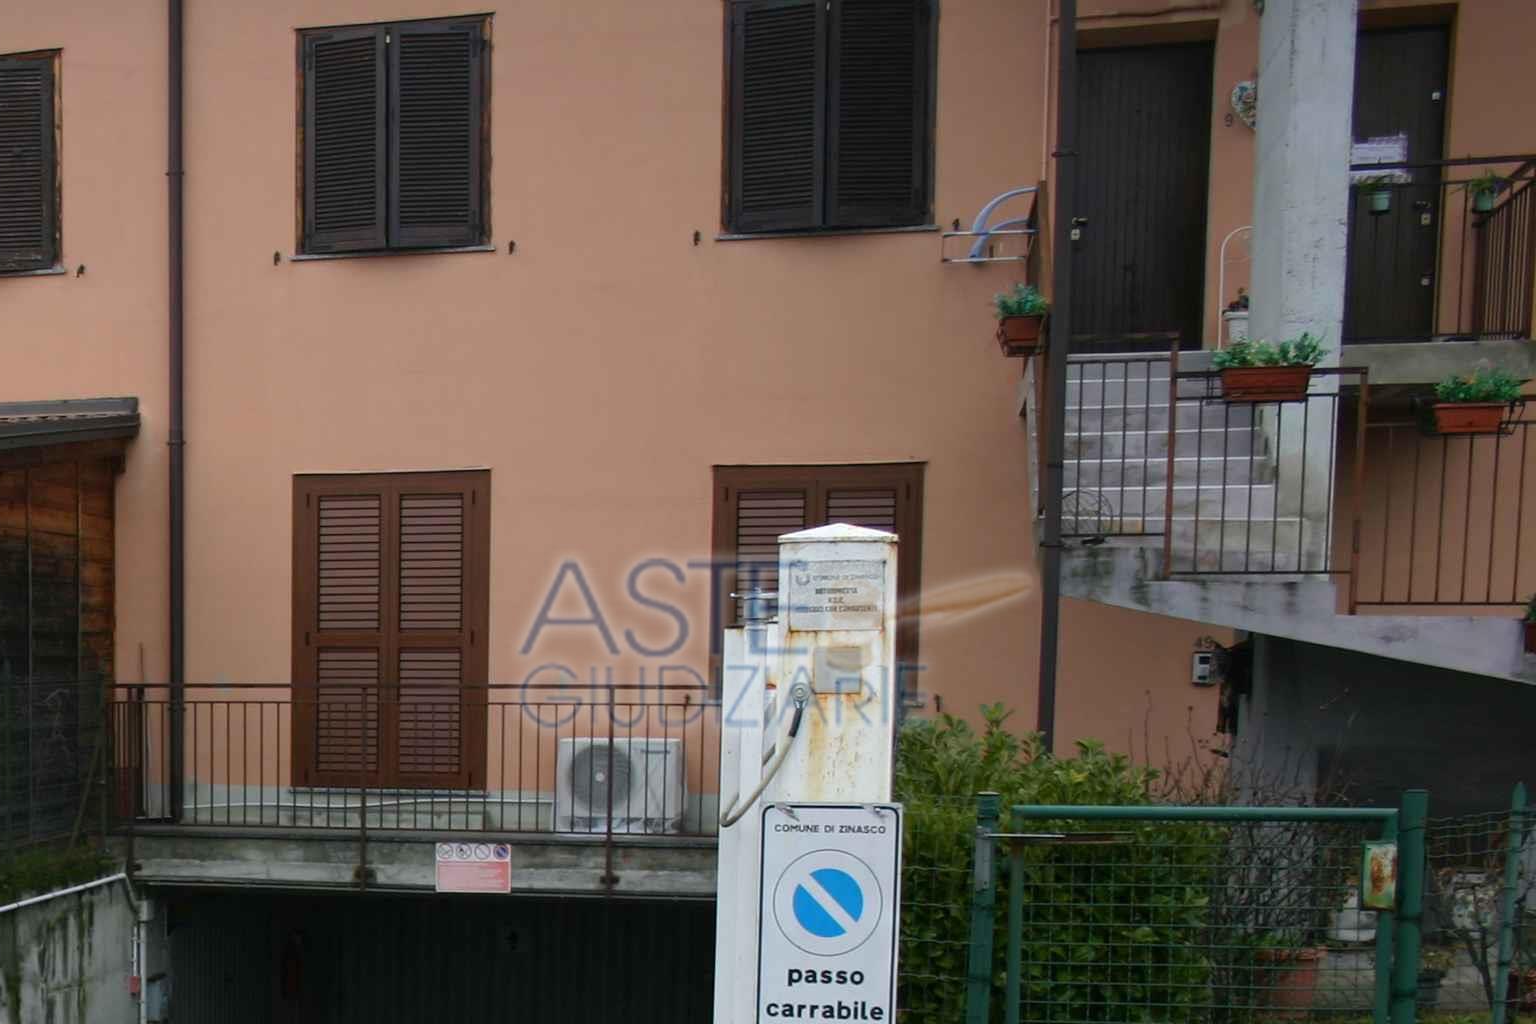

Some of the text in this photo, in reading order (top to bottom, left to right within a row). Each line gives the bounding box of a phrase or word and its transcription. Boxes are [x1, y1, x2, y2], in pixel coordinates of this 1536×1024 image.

[774, 823, 887, 835] COMUNE DI ZINASCO
[787, 967, 865, 987] passo
[765, 1000, 884, 1021] carrabile
